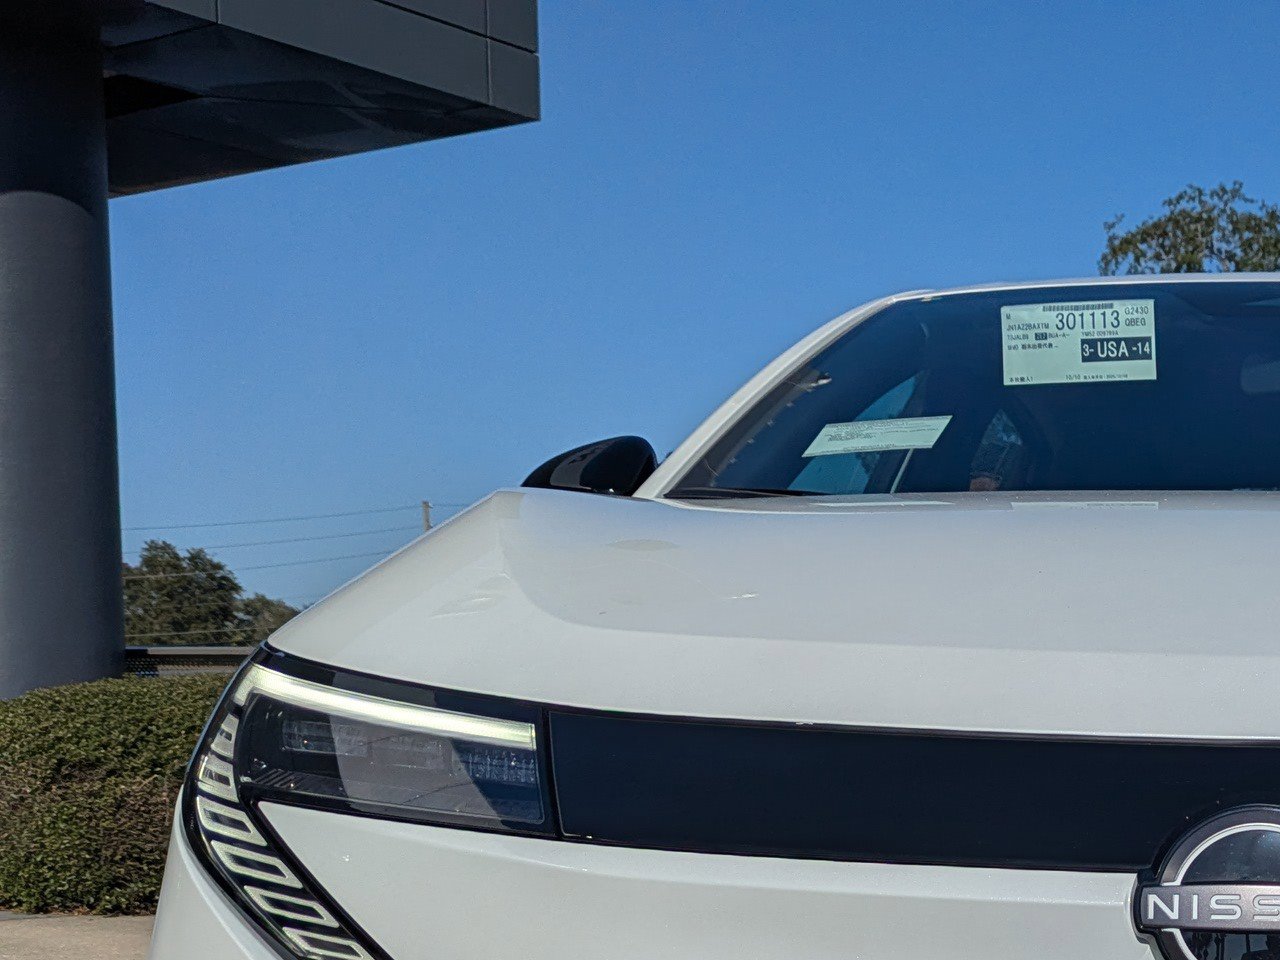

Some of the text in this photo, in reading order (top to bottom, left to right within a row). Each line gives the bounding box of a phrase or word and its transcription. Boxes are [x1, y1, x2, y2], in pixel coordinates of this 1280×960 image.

[1055, 310, 1120, 331] 301113
[1097, 340, 1129, 358] USA
[1132, 341, 1150, 354] -14
